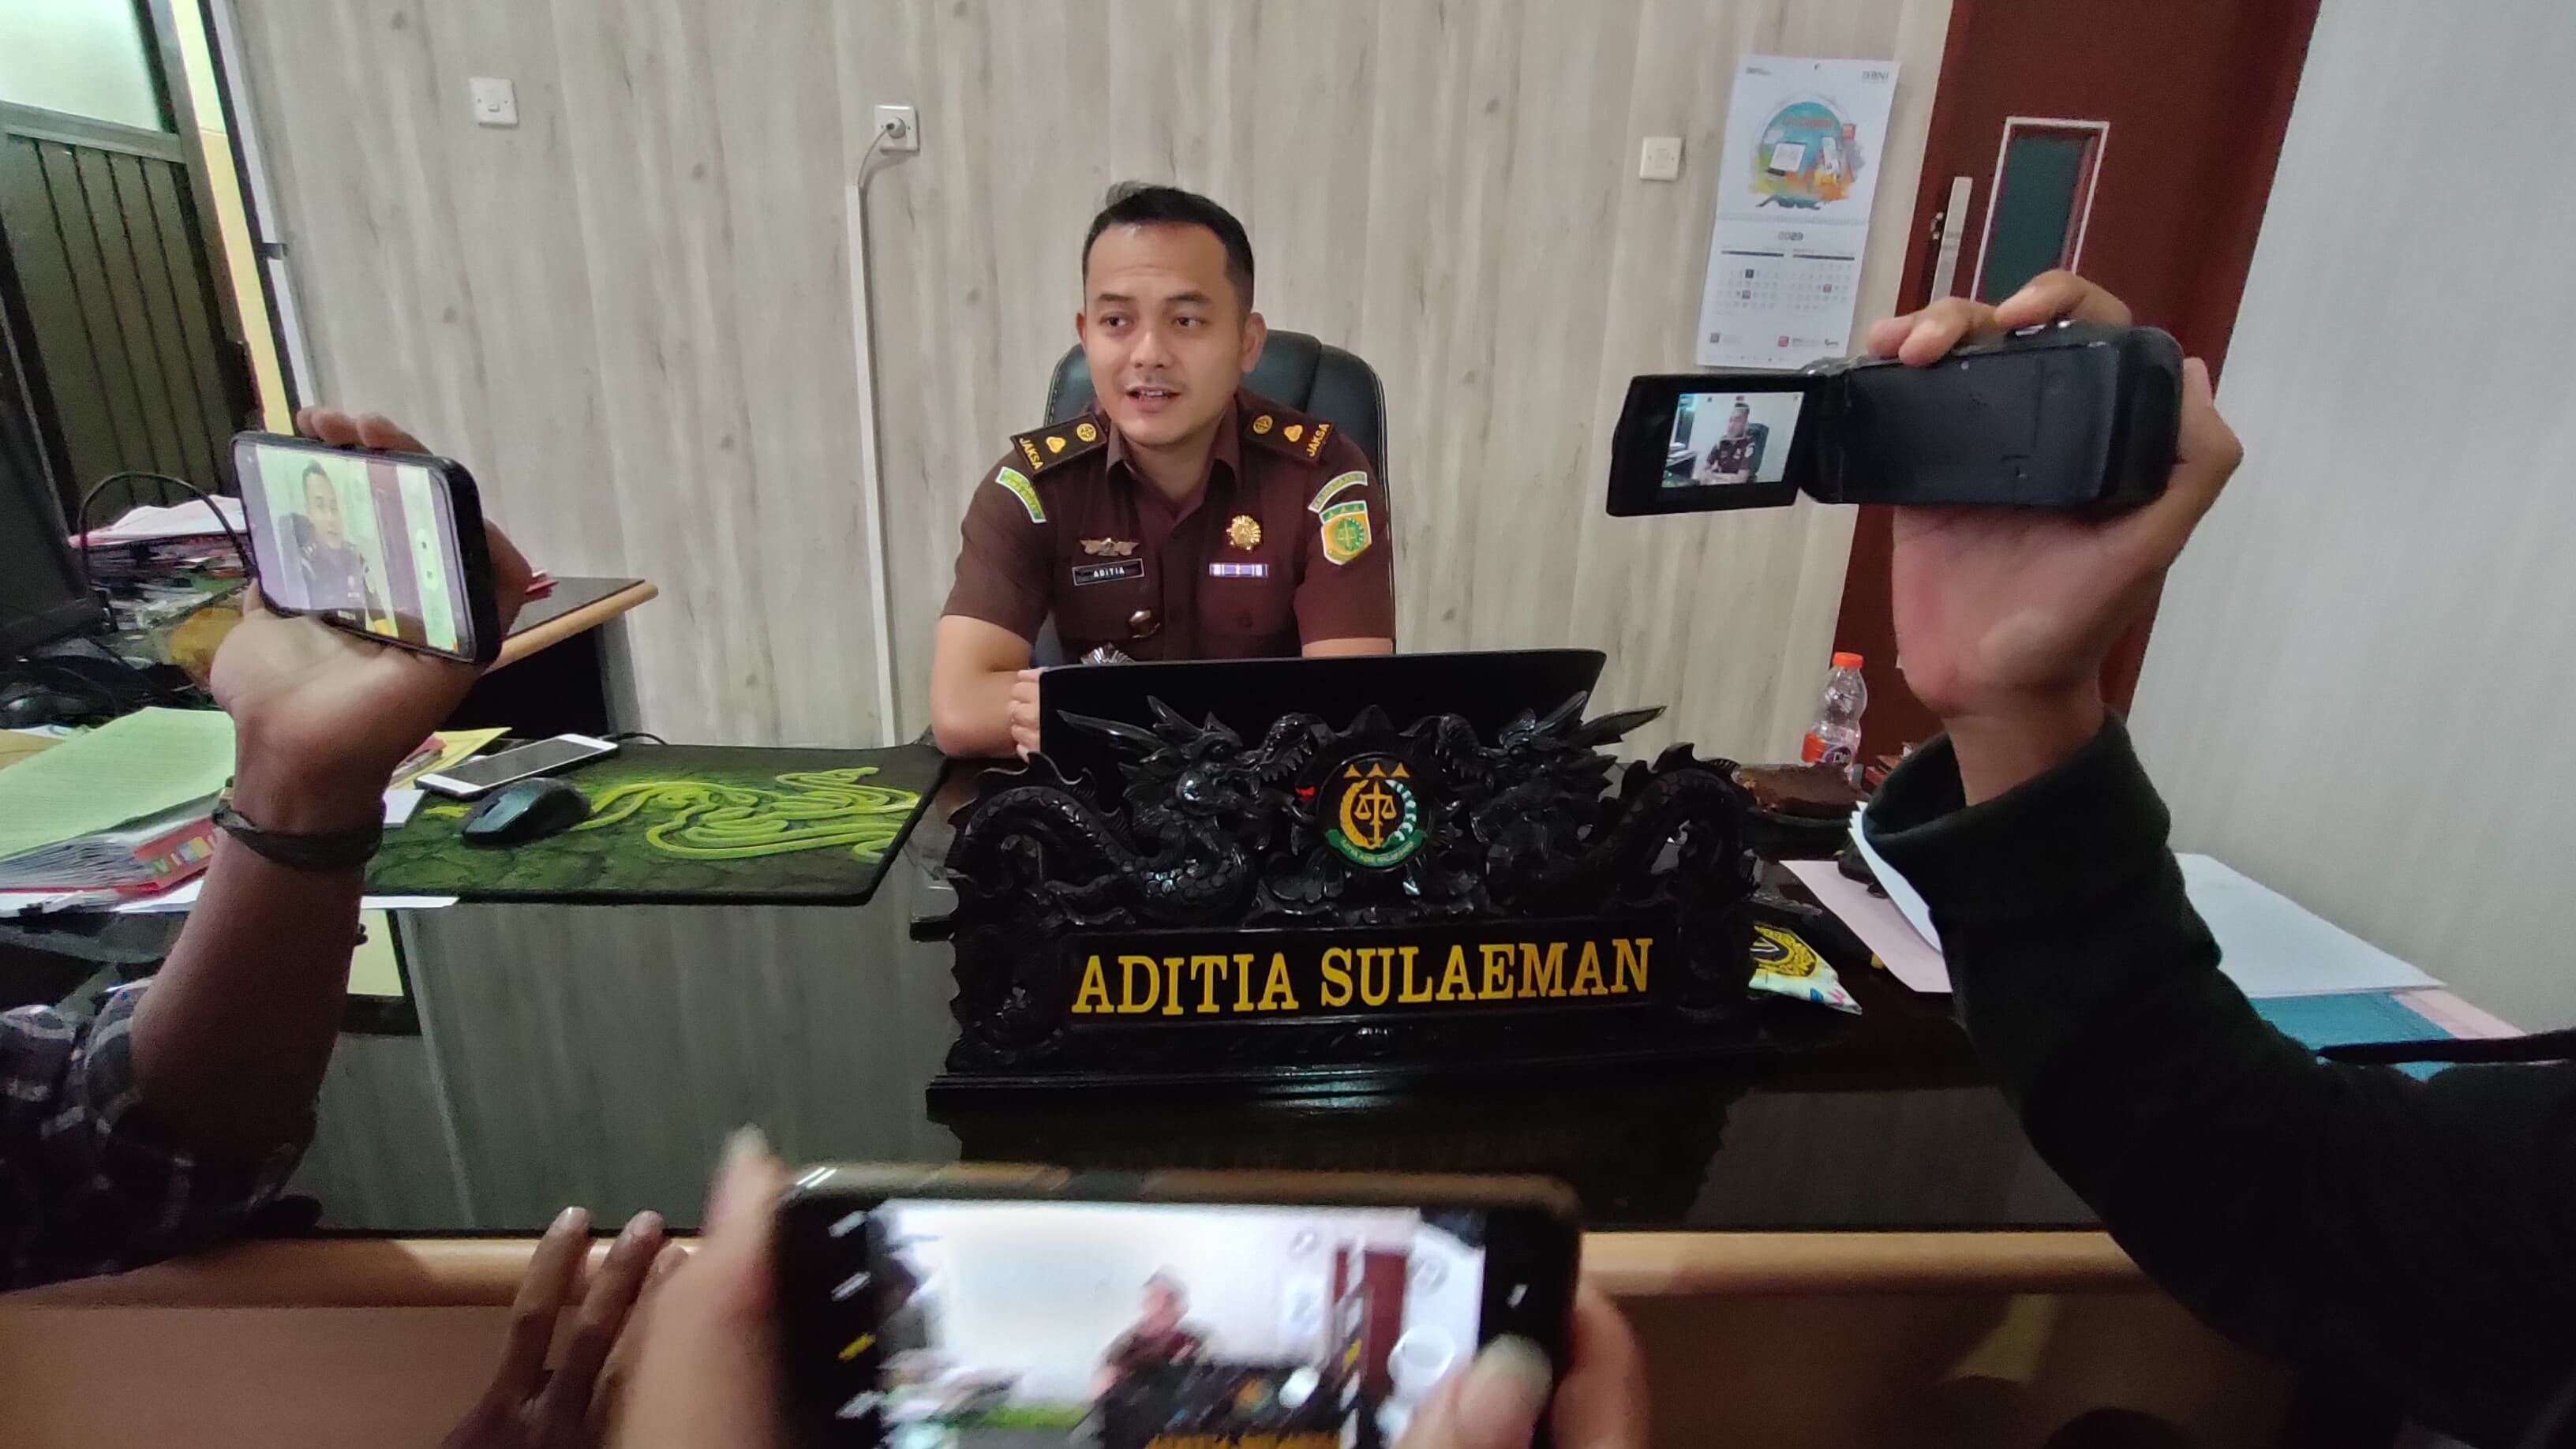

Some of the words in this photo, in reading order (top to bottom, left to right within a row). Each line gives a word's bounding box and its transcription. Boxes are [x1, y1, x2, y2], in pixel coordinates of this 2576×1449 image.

[1019, 437, 1043, 470] JAKSA
[1306, 423, 1330, 457] JAKSA
[1071, 952, 1300, 1016] ADITIA
[1320, 938, 1653, 1007] SULAEMAN
